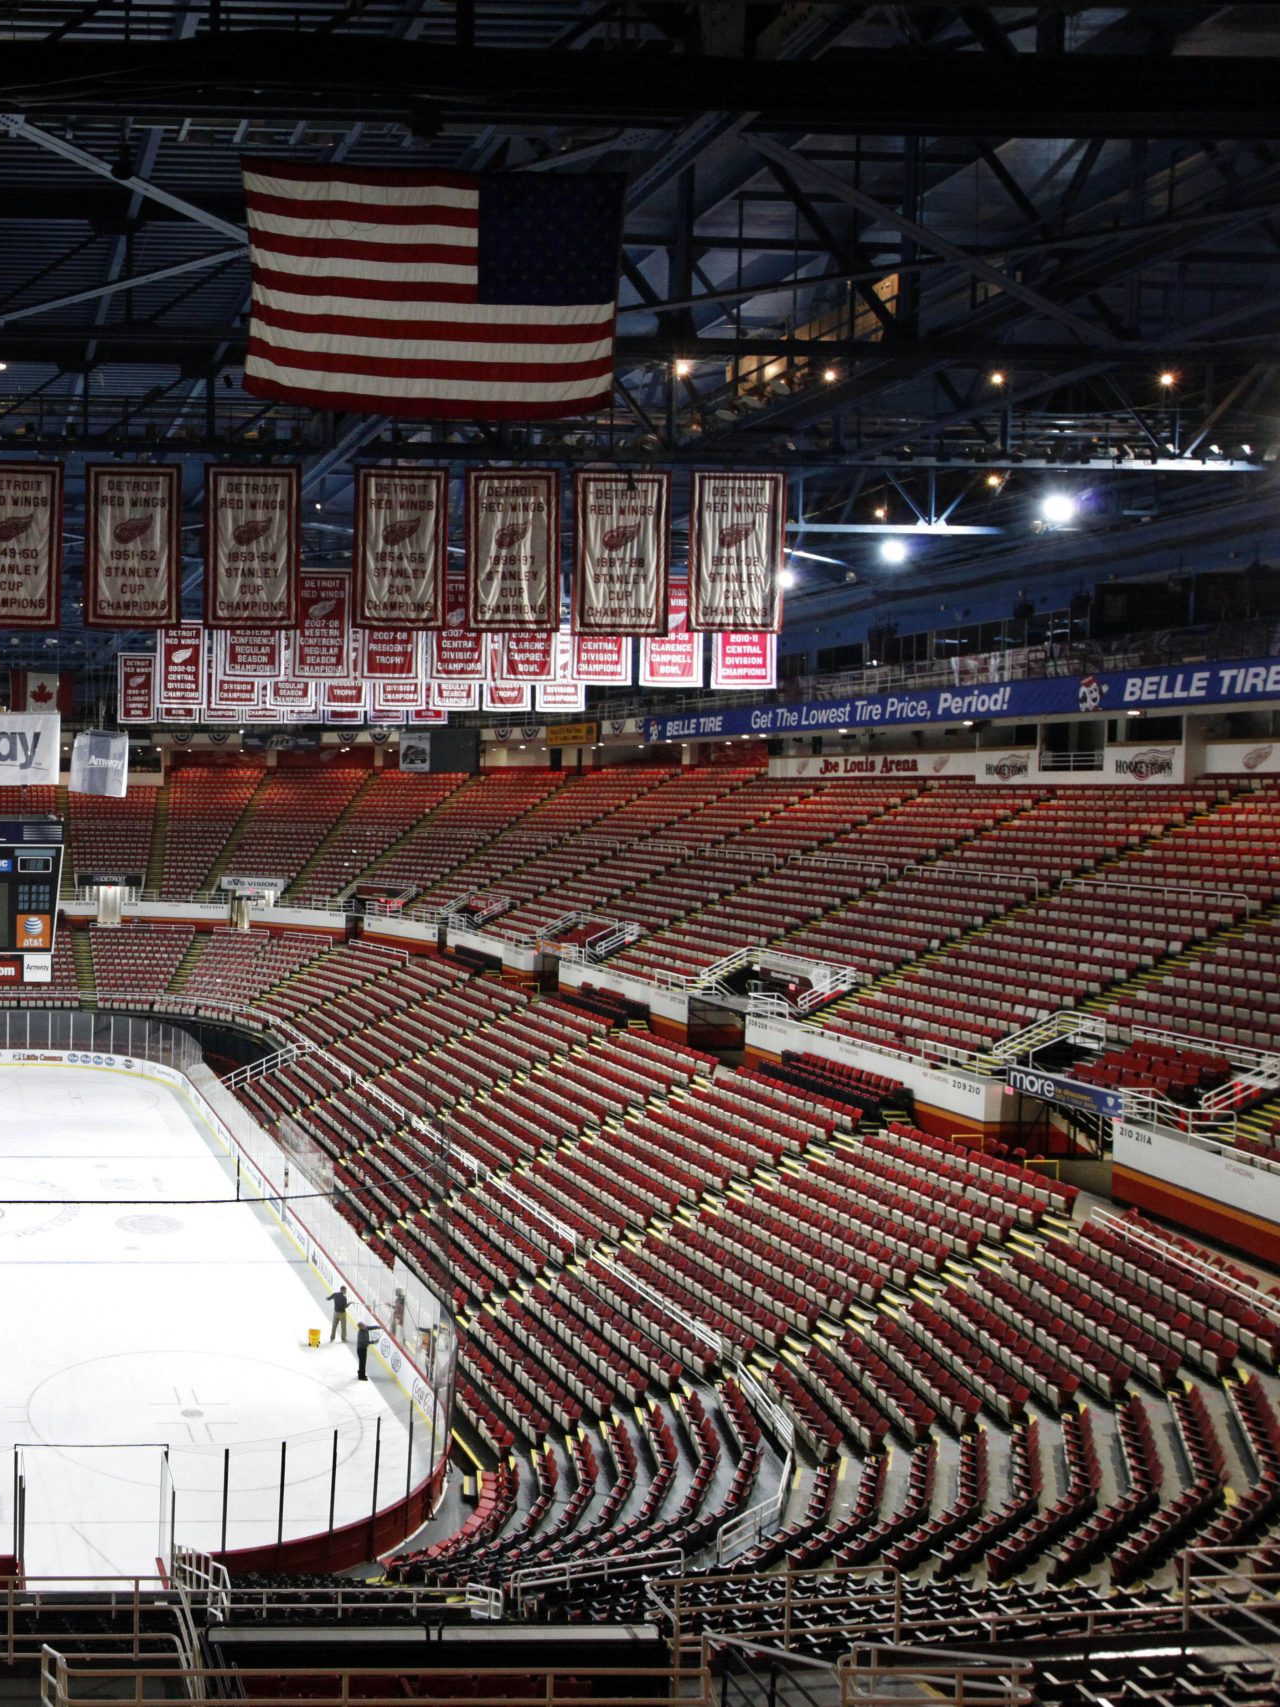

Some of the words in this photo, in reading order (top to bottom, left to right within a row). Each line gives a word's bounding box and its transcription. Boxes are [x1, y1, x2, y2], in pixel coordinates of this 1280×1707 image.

[108, 480, 160, 492] DETROIT
[227, 483, 280, 494] DETROIT
[375, 484, 429, 495] DETROIT
[486, 486, 539, 497] DETROIT
[595, 489, 649, 500] DETROIT
[712, 487, 765, 497] DETROIT
[12, 496, 48, 507] WINGS
[101, 496, 125, 507] RED
[130, 497, 166, 508] WINGS
[221, 498, 243, 509] RED
[250, 500, 285, 510] WINGS
[370, 500, 392, 510] RED
[399, 501, 434, 510] WINGS
[481, 502, 503, 513] RED
[511, 502, 545, 512] WINGS
[590, 505, 613, 515] RED
[619, 506, 654, 516] WINGS
[706, 502, 729, 513] RED
[735, 503, 770, 513] WINGS
[110, 551, 157, 561] 1951-52
[228, 552, 277, 563] 1953-54
[105, 567, 160, 578] STANLEY
[225, 568, 279, 579] STANLEY
[374, 569, 427, 579] STANLEY
[487, 571, 538, 581] STANLEY
[709, 573, 762, 583] STANLEY
[593, 574, 648, 584] STANLEY
[0, 581, 24, 591] CUP
[121, 584, 145, 594] CUP
[240, 584, 264, 595] CUP
[388, 585, 412, 595] CUP
[501, 588, 525, 598] CUP
[608, 591, 633, 601] CUP
[724, 590, 747, 600] CUP
[99, 601, 167, 611] CHAMPIONS
[219, 601, 286, 612] CHAMPIONS
[366, 601, 434, 612] CHAMPIONS
[479, 604, 546, 615] CHAMPIONS
[702, 606, 768, 617] CHAMPIONS
[586, 606, 653, 618] CHAMPIONS
[373, 632, 408, 640] 2007-08
[235, 646, 270, 654] REGULAR
[582, 642, 618, 650] CENTRAL
[725, 646, 762, 654] CENTRAL
[376, 656, 405, 664] TROPHY
[441, 651, 478, 659] DIVISION
[581, 653, 618, 661] DIVISION
[438, 662, 482, 670] CHAMPIONS
[578, 664, 621, 672] CHAMPIONS
[721, 668, 766, 676] CHAMPIONS
[1123, 672, 1210, 702] BELLE
[1219, 664, 1280, 695] TIRE
[751, 710, 773, 729] Get
[776, 708, 798, 727] The
[801, 703, 850, 725] Lowest
[854, 700, 882, 722] Tire
[885, 697, 932, 720] Price,
[937, 687, 1011, 715] Period!
[666, 720, 697, 736] BELLE
[699, 716, 723, 733] TIRE
[88, 754, 124, 768] Amway
[820, 759, 839, 775] Joe
[844, 757, 876, 773] Louis
[880, 757, 918, 774] Arena
[23, 938, 43, 946] at&t
[26, 963, 49, 972] Amway
[952, 1080, 966, 1091] 209
[967, 1084, 980, 1095] 210
[1009, 1069, 1055, 1098] more
[1120, 1126, 1134, 1139] 210
[1136, 1130, 1153, 1146] 211A
